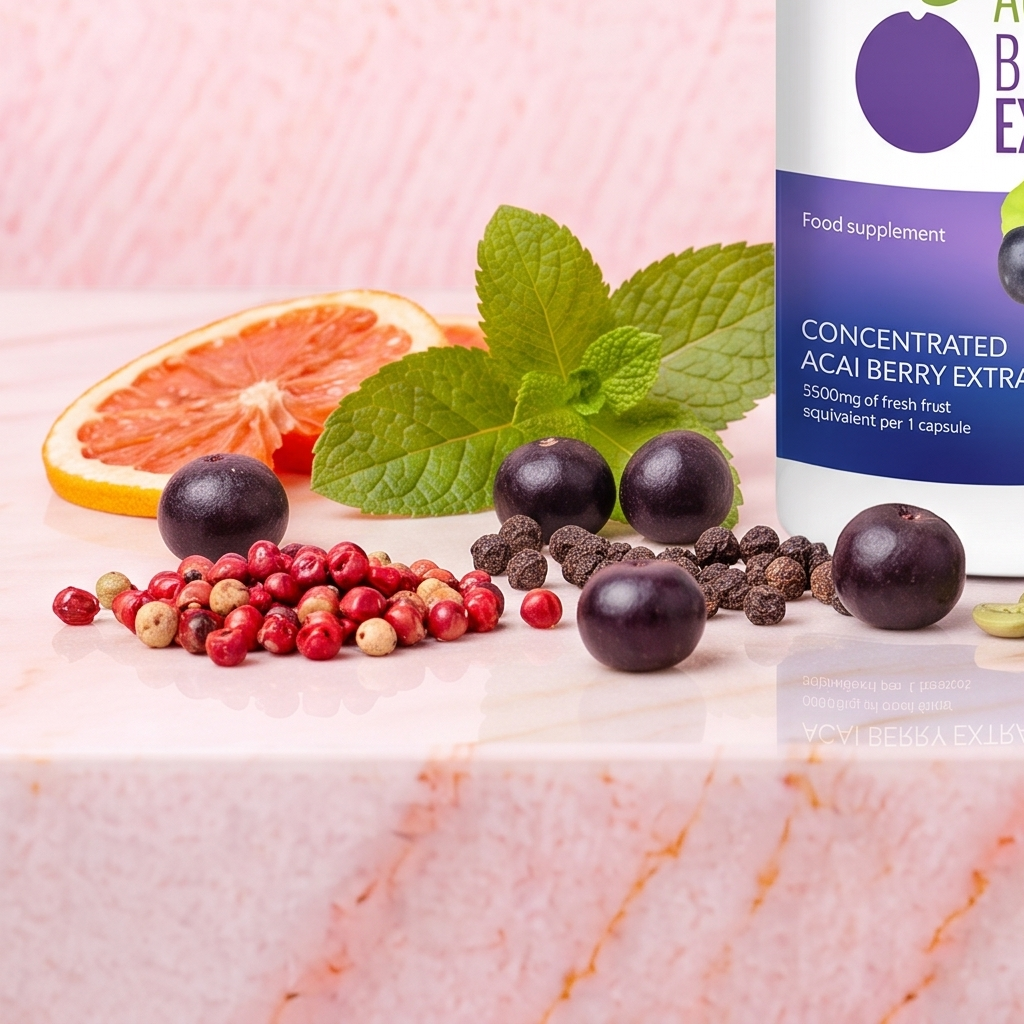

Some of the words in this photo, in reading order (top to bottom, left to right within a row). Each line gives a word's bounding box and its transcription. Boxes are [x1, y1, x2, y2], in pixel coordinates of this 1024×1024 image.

[803, 211, 843, 232] Food
[847, 221, 946, 242] supplement
[801, 319, 1008, 357] CONCENTRATED
[801, 350, 859, 378] ACAI
[867, 358, 947, 386] BERRY
[864, 394, 879, 407] of
[882, 395, 917, 411] fresh
[880, 417, 903, 431] per
[908, 418, 914, 430] 1
[918, 420, 971, 435] capsule
